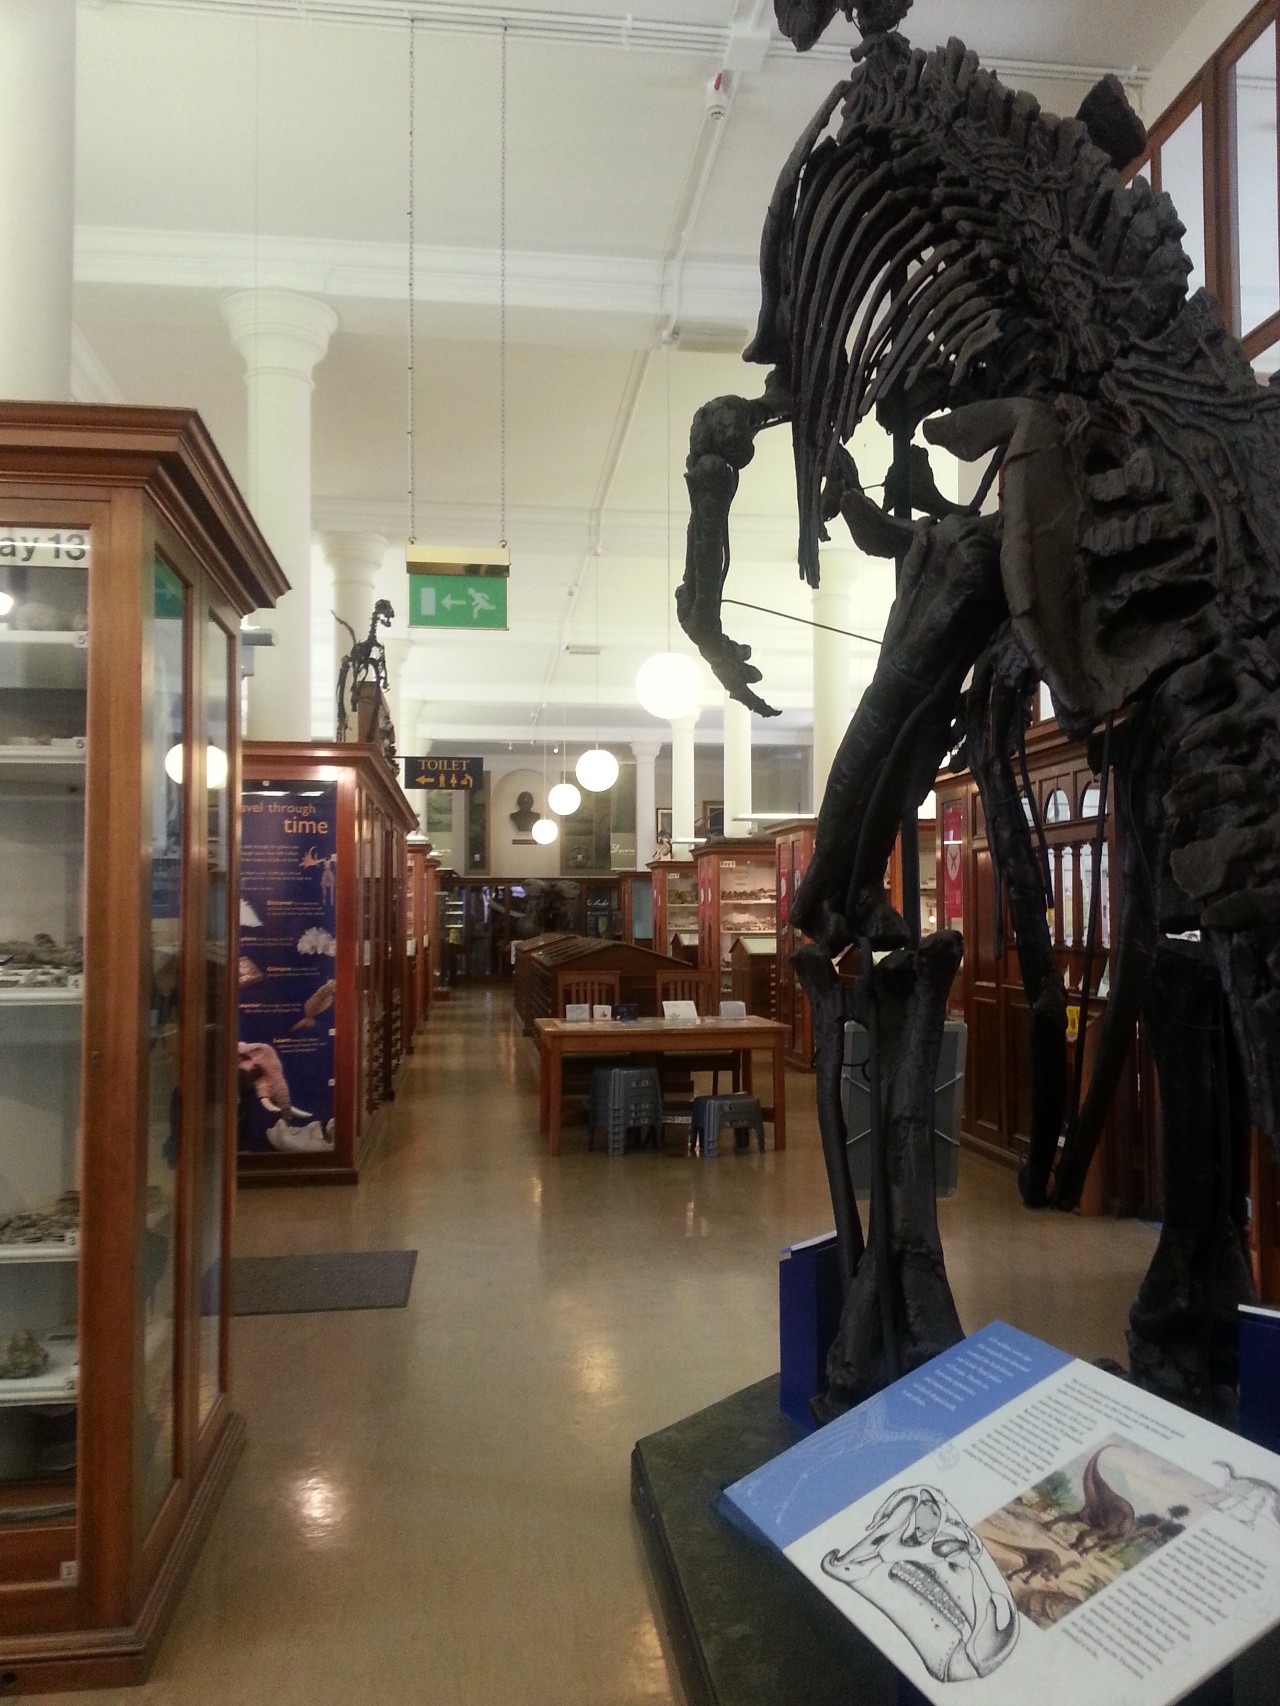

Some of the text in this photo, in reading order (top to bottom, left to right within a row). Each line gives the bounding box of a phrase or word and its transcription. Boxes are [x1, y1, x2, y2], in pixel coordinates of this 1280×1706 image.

[48, 533, 86, 561] 13
[78, 635, 85, 645] 5
[76, 739, 85, 749] 5
[418, 759, 470, 771] TOILET
[268, 802, 316, 817] through
[283, 816, 329, 834] time
